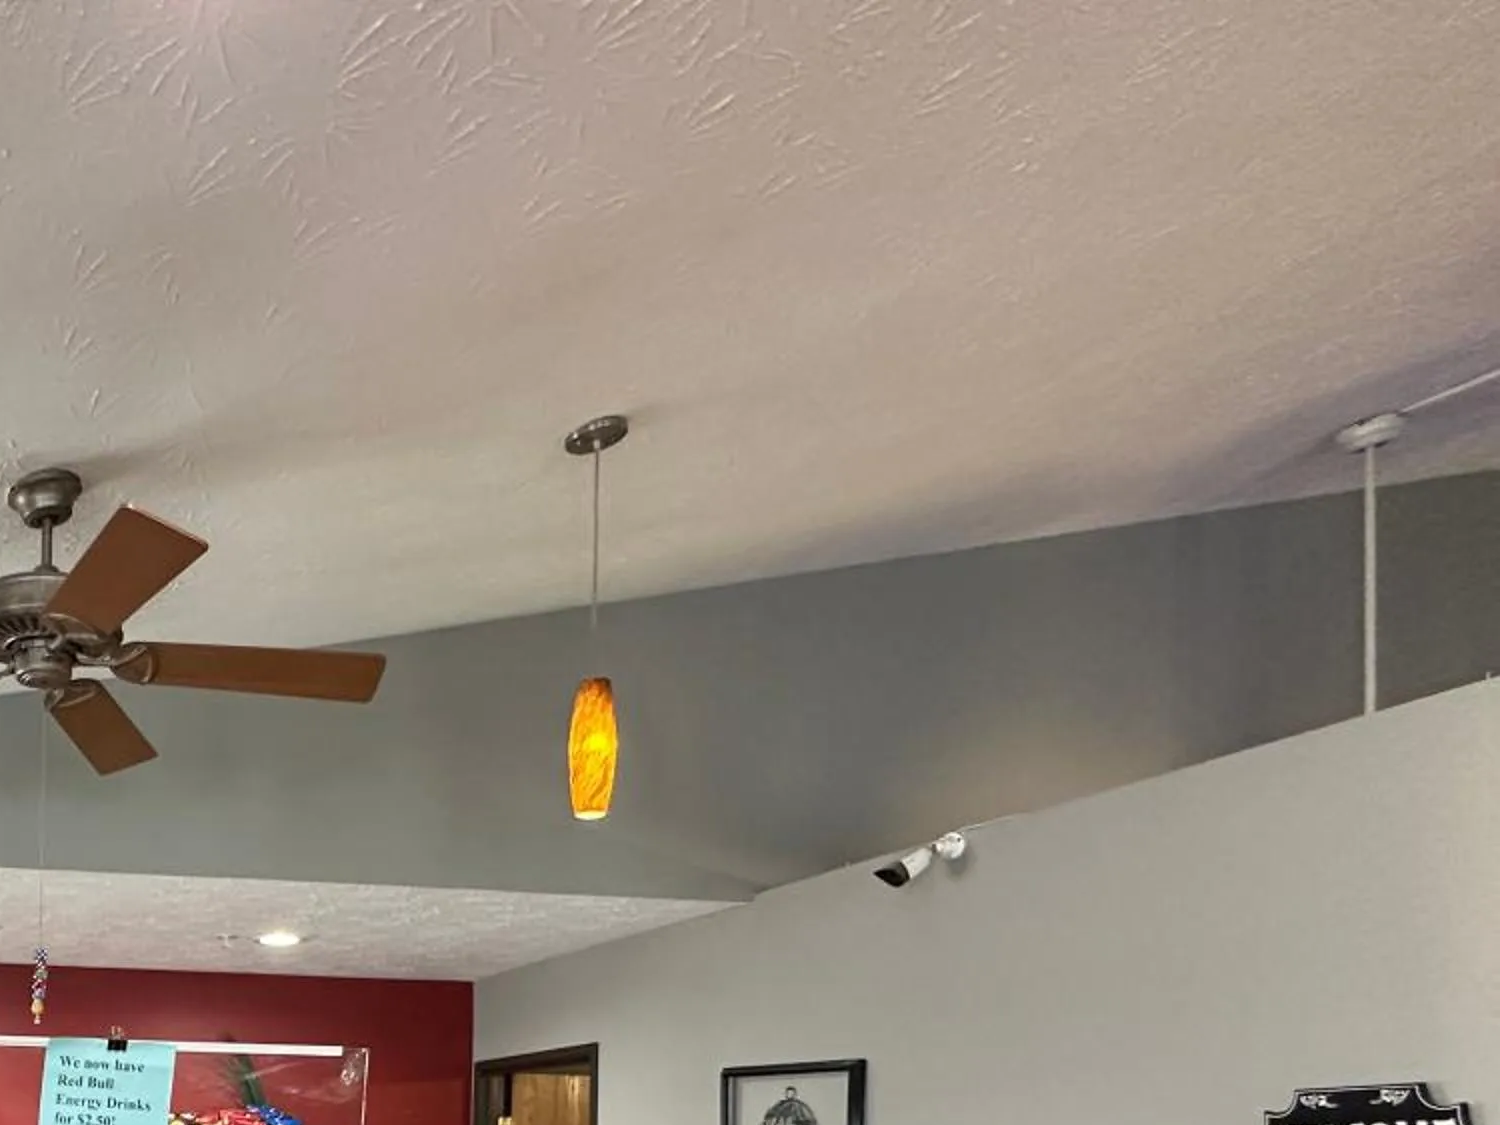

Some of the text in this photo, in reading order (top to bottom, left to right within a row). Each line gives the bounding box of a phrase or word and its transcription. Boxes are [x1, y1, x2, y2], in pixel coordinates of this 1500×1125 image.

[59, 1055, 145, 1073] We now have
[57, 1074, 115, 1090] Red Bull
[55, 1093, 152, 1112] Energy Drinks
[55, 1112, 74, 1125] for
